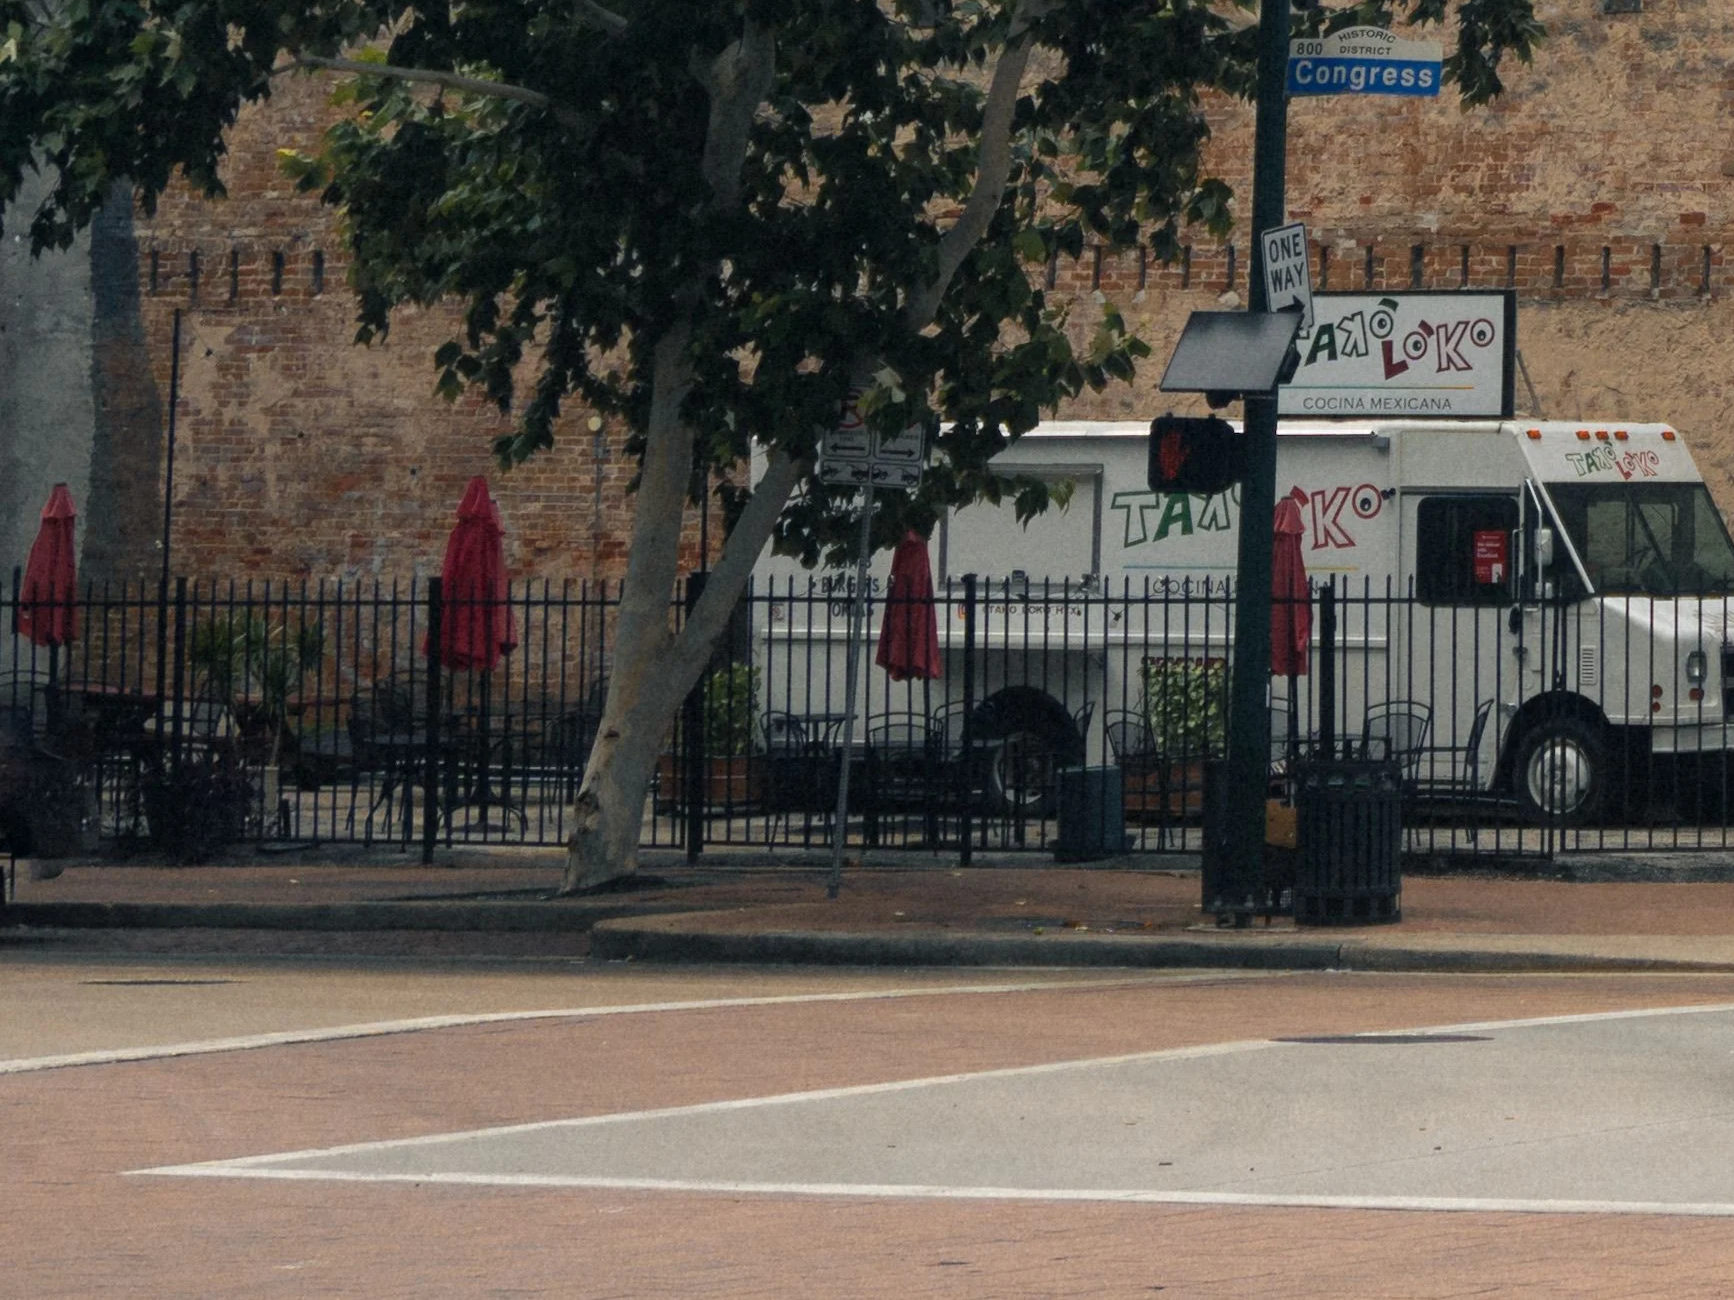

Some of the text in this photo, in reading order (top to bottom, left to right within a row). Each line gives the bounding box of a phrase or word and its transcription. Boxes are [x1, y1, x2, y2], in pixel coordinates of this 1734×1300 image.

[1337, 28, 1397, 45] HISTORIC
[1295, 41, 1393, 57] 800 DISTRICT
[1294, 60, 1434, 91] Congress
[1268, 232, 1303, 264] ONE
[1270, 262, 1305, 294] WAY
[1302, 395, 1453, 411] COCINA MEXICANA
[1152, 577, 1227, 596] COCINA
